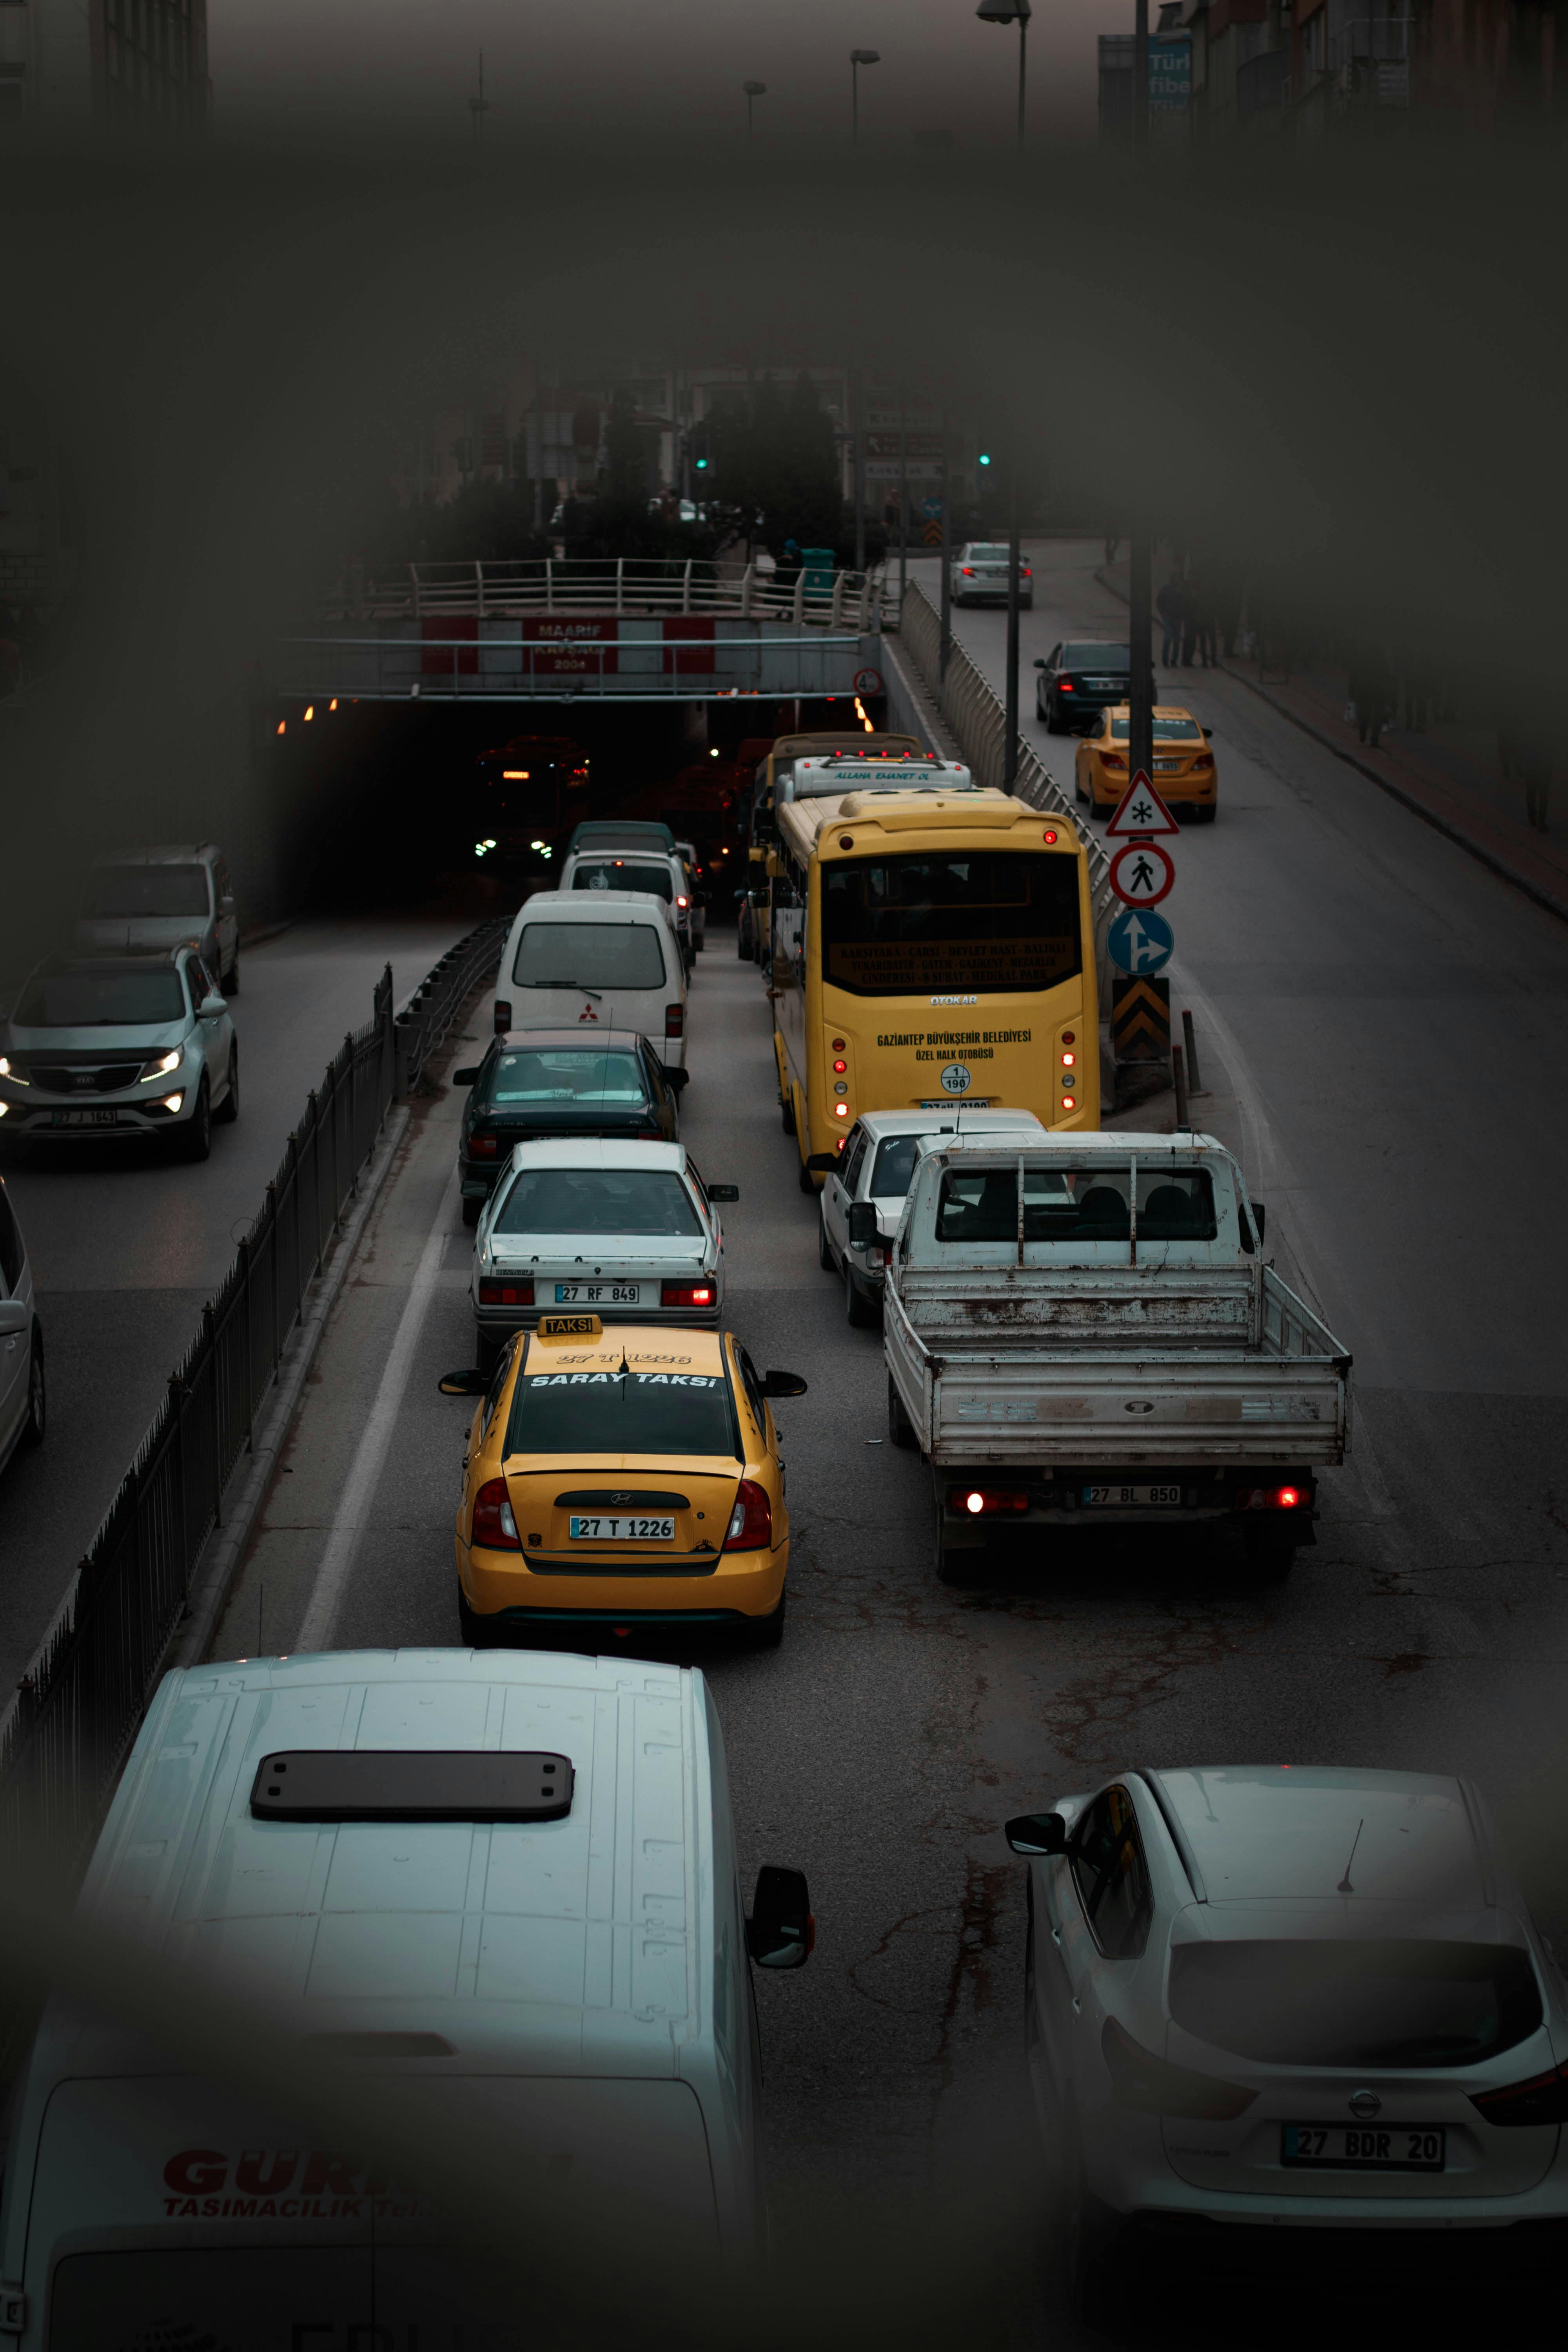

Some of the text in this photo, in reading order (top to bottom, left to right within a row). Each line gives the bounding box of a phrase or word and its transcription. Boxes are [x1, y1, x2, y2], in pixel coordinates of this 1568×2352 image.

[538, 622, 602, 637] MAARİF
[554, 659, 586, 670] 2004
[948, 945, 987, 956] DEVLET
[990, 944, 1017, 955] HAST
[1024, 942, 1066, 954] BALIKLI
[1020, 969, 1047, 980] PARK
[930, 996, 977, 1005] OTOKAR
[877, 1028, 1031, 1046] GAZİANTEP BÜYÜKŞEHİR BELEDİYESİ
[916, 1047, 993, 1061] ÖZEL HALK OTOBÜSÜ
[953, 1067, 958, 1076] 1
[946, 1079, 965, 1089] 190
[58, 1112, 114, 1122] 27 J 1643
[563, 1287, 578, 1301] 27
[588, 1288, 603, 1300] RF
[612, 1287, 636, 1301] 849
[557, 1354, 692, 1364] 27 T 1226
[530, 1373, 631, 1387] SARAY
[1091, 1488, 1109, 1503] 27
[1121, 1488, 1139, 1503] BL
[1150, 1488, 1178, 1501] 850
[579, 1519, 601, 1535] 27
[609, 1520, 619, 1536] T
[629, 1520, 671, 1537] 1226
[1298, 2131, 1328, 2156] 27
[1346, 2132, 1390, 2158] BDR
[1408, 2134, 1438, 2159] 20
